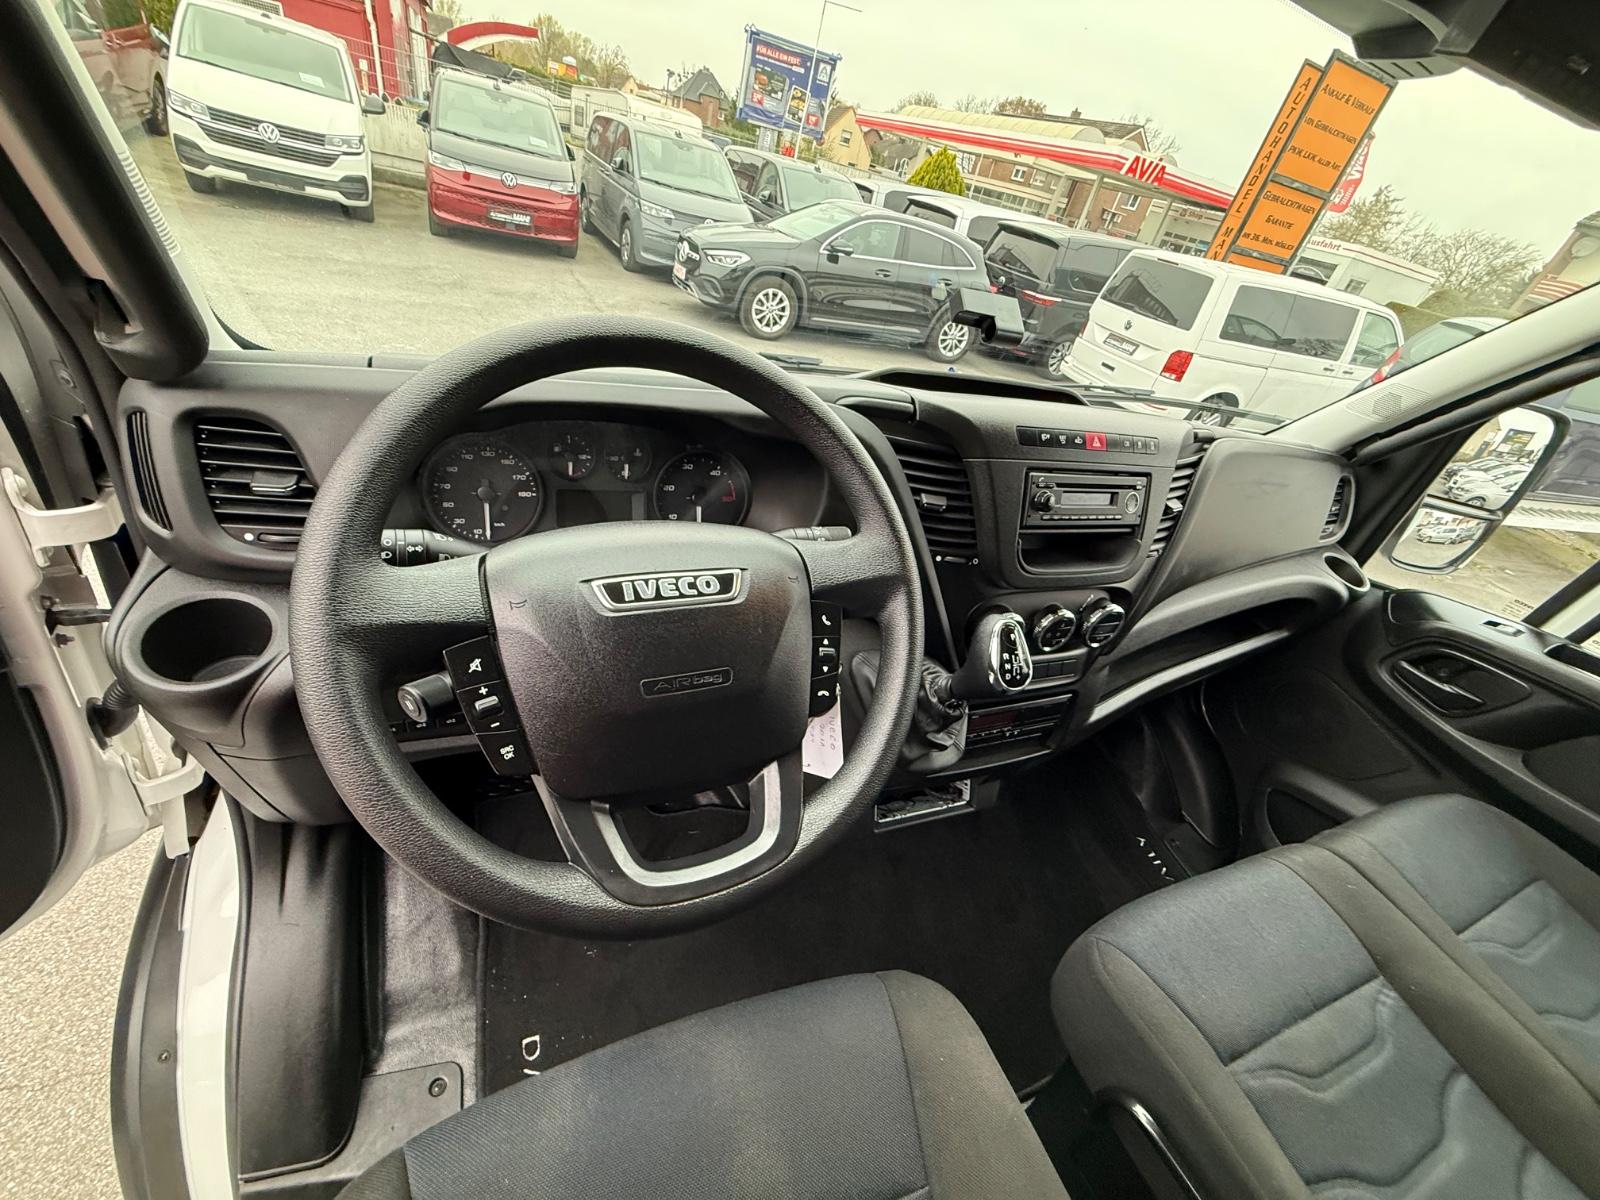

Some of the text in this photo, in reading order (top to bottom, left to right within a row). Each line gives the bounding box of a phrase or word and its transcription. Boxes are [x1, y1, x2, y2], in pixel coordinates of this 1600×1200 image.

[1235, 77, 1311, 214] AUTOHANDEL
[1124, 155, 1166, 186] AVIA
[621, 575, 720, 602] IVECO
[499, 744, 515, 755] SRC
[503, 751, 516, 760] OK
